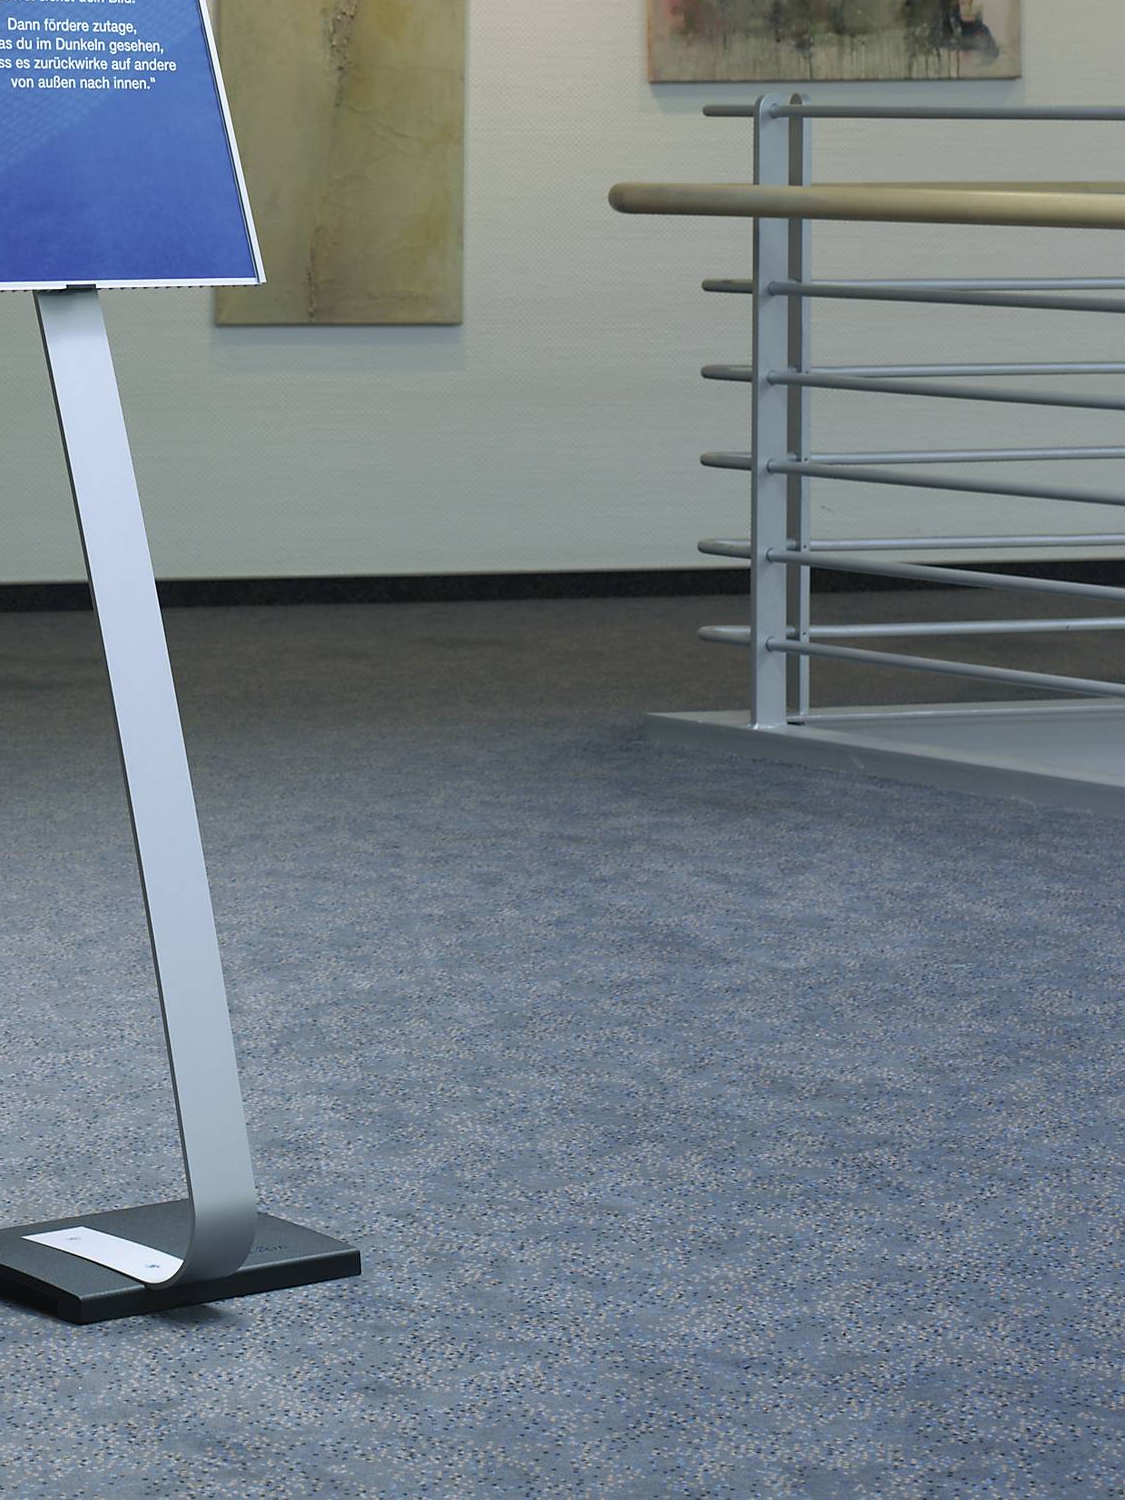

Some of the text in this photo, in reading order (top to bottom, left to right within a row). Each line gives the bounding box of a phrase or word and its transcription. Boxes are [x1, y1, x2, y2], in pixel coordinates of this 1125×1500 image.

[8, 17, 137, 35] Dann fördere zutage,
[16, 37, 32, 50] du
[36, 37, 51, 50] im
[55, 37, 105, 51] Dunkeln
[109, 38, 164, 54] gesehen,
[16, 58, 30, 69] es
[33, 56, 108, 70] zurückwirke
[112, 57, 130, 71] auf
[134, 58, 176, 72] andere
[11, 77, 34, 88] von
[38, 76, 75, 89] außen
[79, 76, 109, 89] nach
